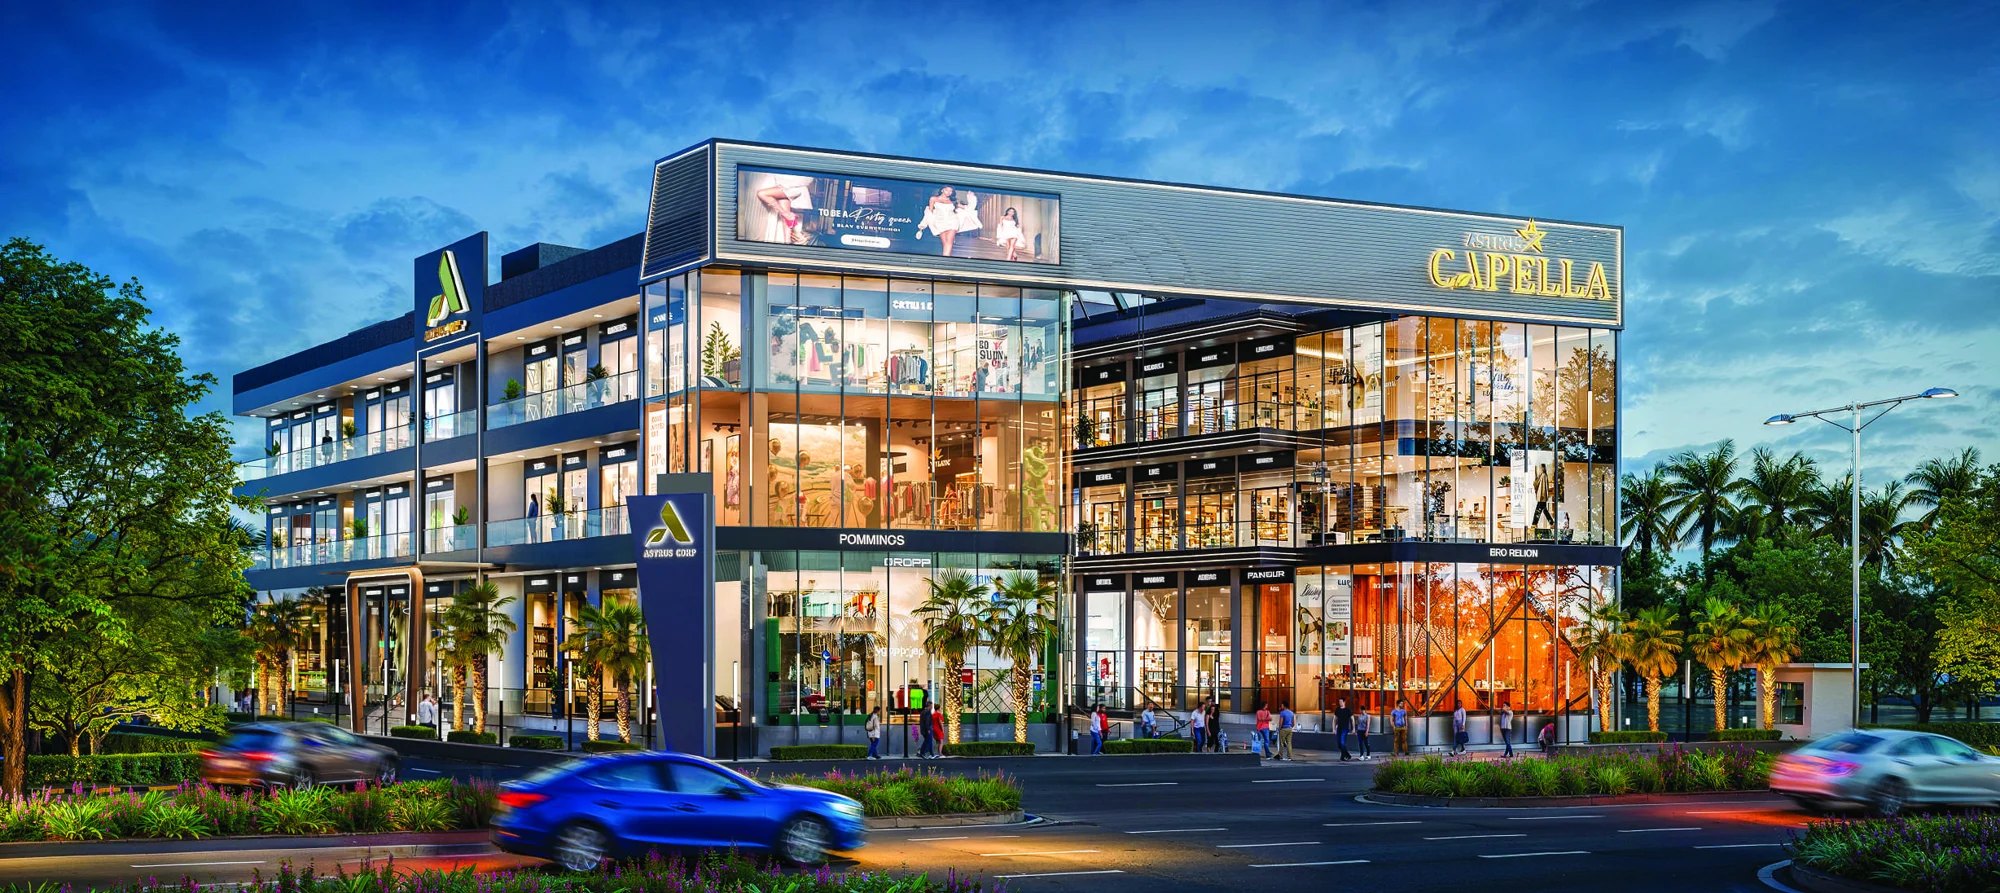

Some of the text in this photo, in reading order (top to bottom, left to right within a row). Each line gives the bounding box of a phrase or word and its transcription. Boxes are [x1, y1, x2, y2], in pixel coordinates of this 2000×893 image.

[818, 208, 829, 217] TO
[830, 209, 841, 217] BE
[848, 206, 886, 225] Party
[1466, 232, 1524, 252] ASTRUS
[1429, 248, 1613, 301] CAPELLA
[643, 548, 697, 558] ASTRUS CORP
[1509, 549, 1538, 558] RELION
